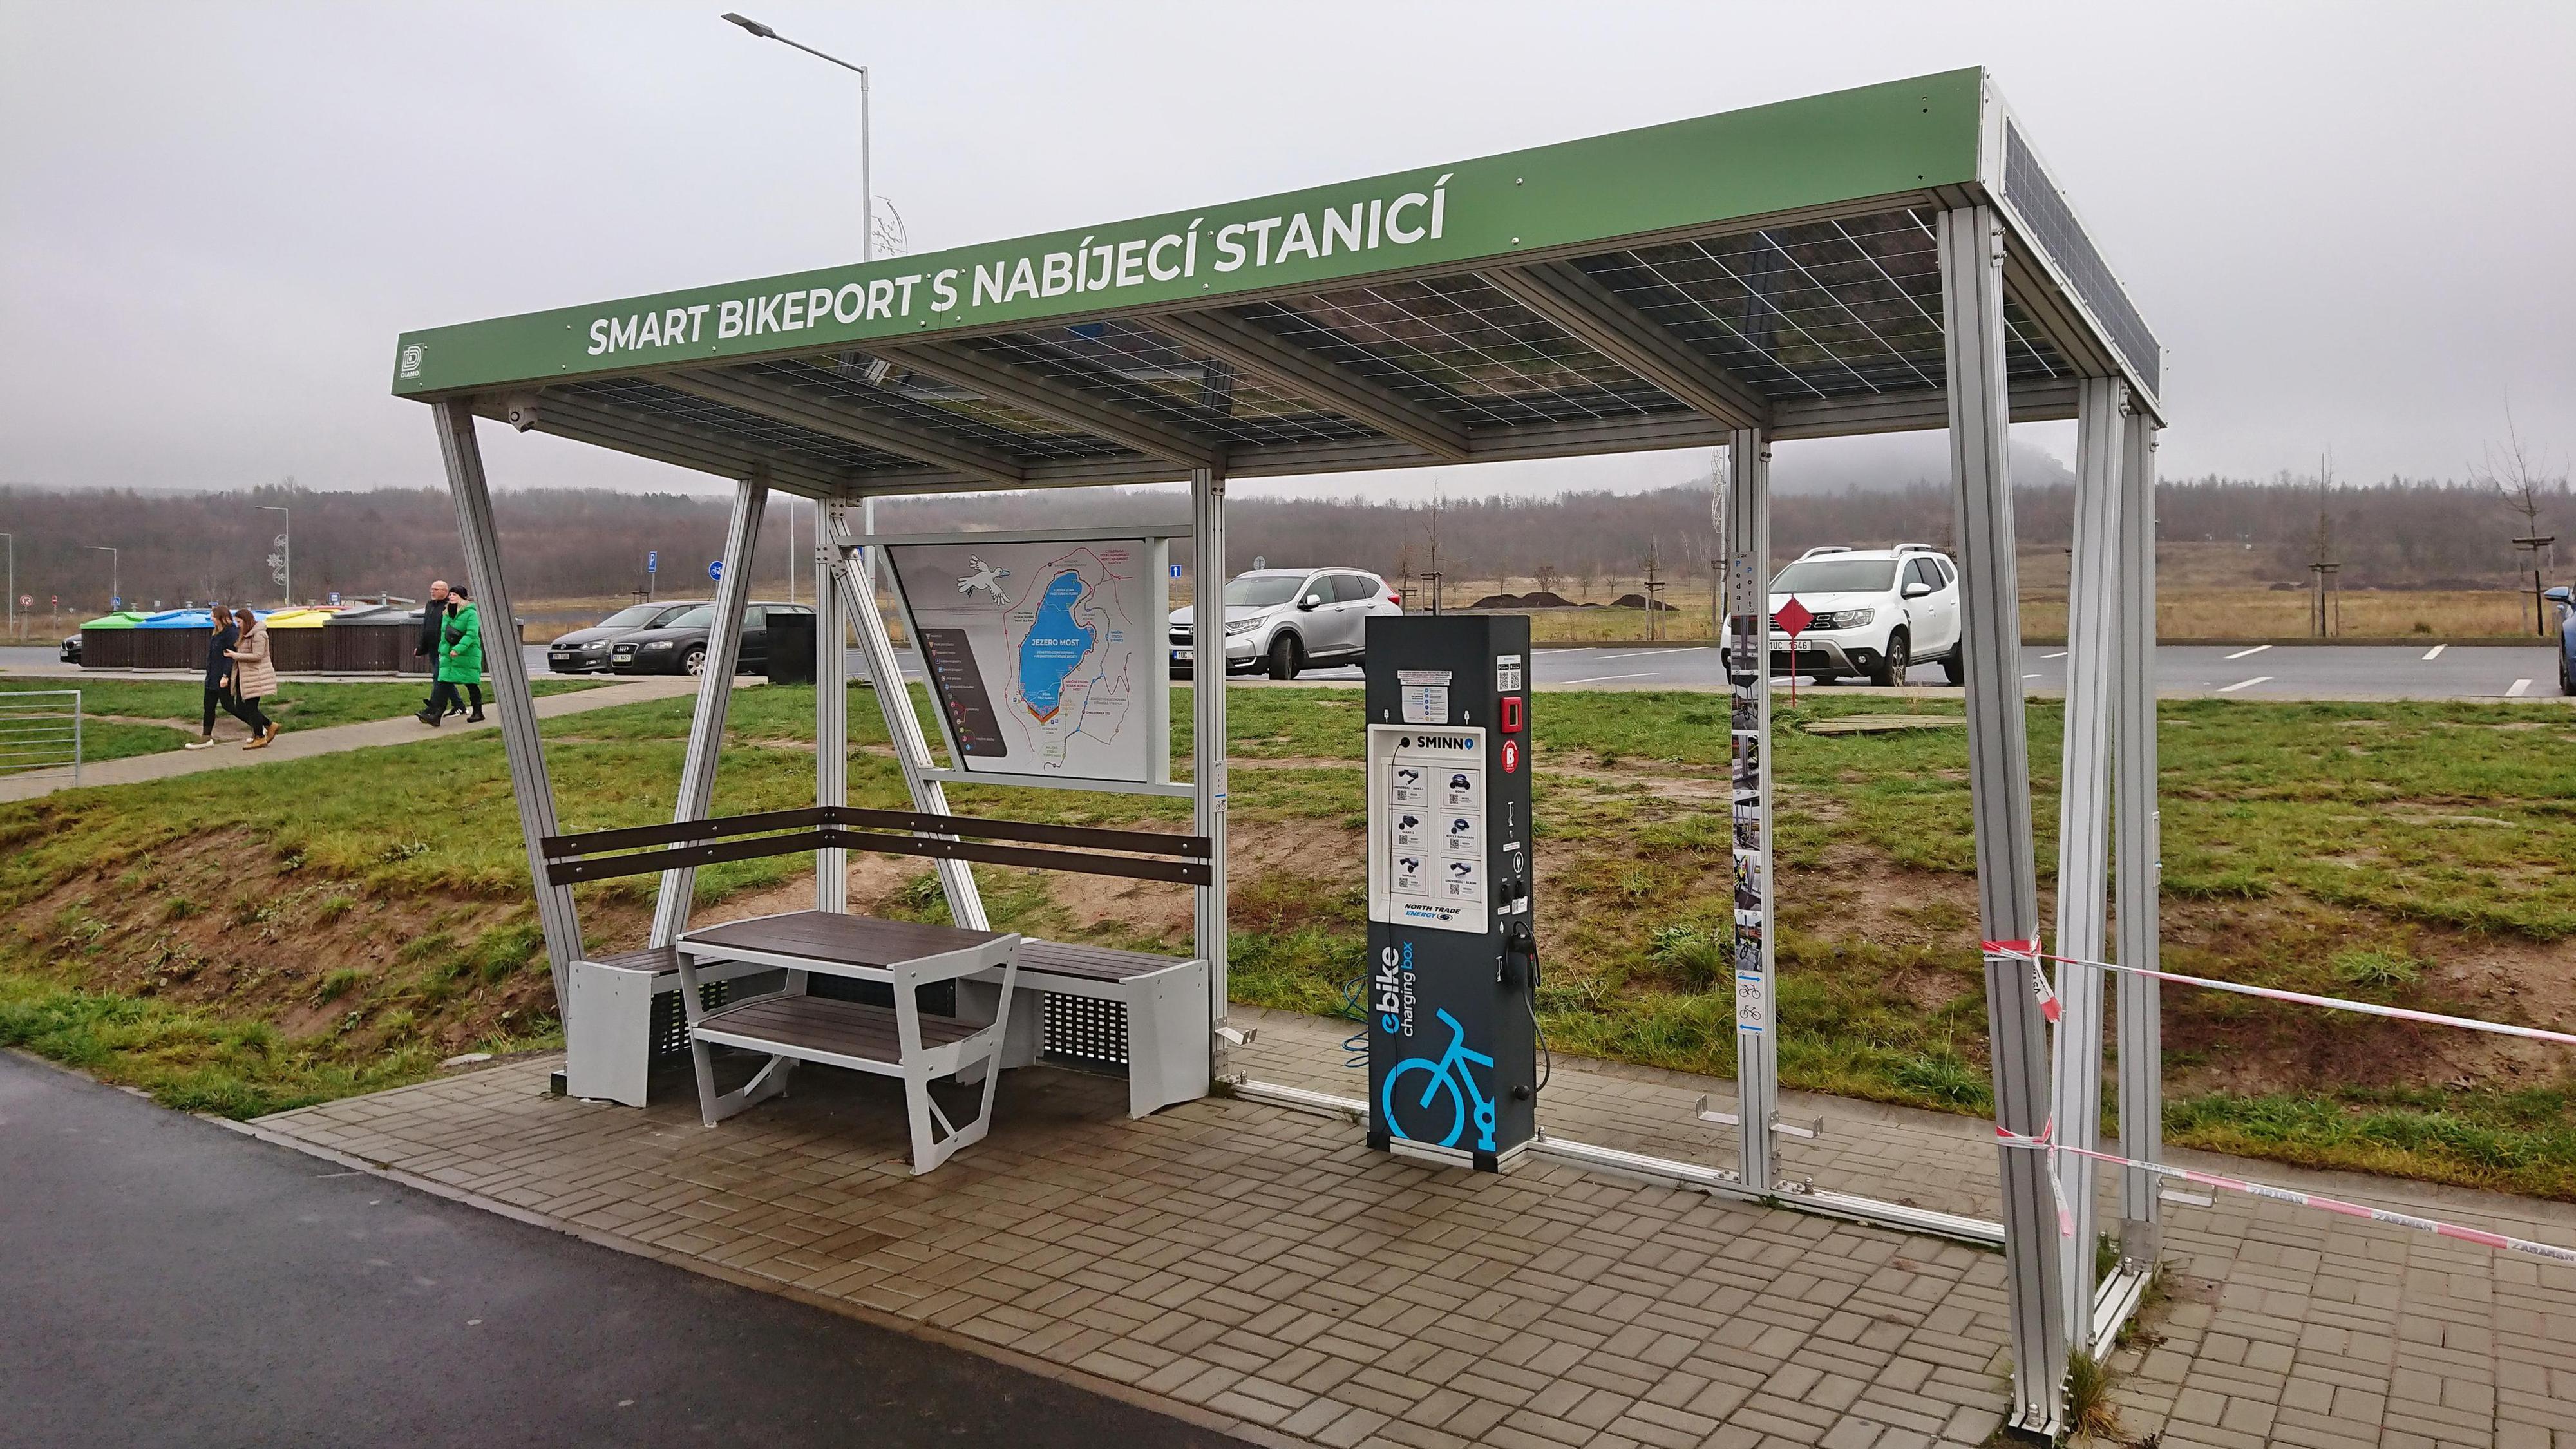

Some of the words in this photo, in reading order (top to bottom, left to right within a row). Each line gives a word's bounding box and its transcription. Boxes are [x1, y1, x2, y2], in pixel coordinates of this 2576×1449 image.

[587, 304, 710, 356] SMART
[718, 274, 922, 339] BIKEPORT
[930, 269, 958, 312] S
[972, 217, 1204, 307] NABÍJECÍ
[1213, 173, 1454, 272] STANICÍ
[401, 370, 419, 378] DIAMO
[650, 554, 655, 565] P
[1506, 748, 1514, 764] B
[1405, 903, 1432, 911] NORTH
[1435, 906, 1461, 914] TRADE
[1405, 910, 1437, 918] ENERGY
[1401, 940, 1412, 970] box
[1376, 947, 1400, 1034] ebike
[1401, 972, 1416, 1037] charging
